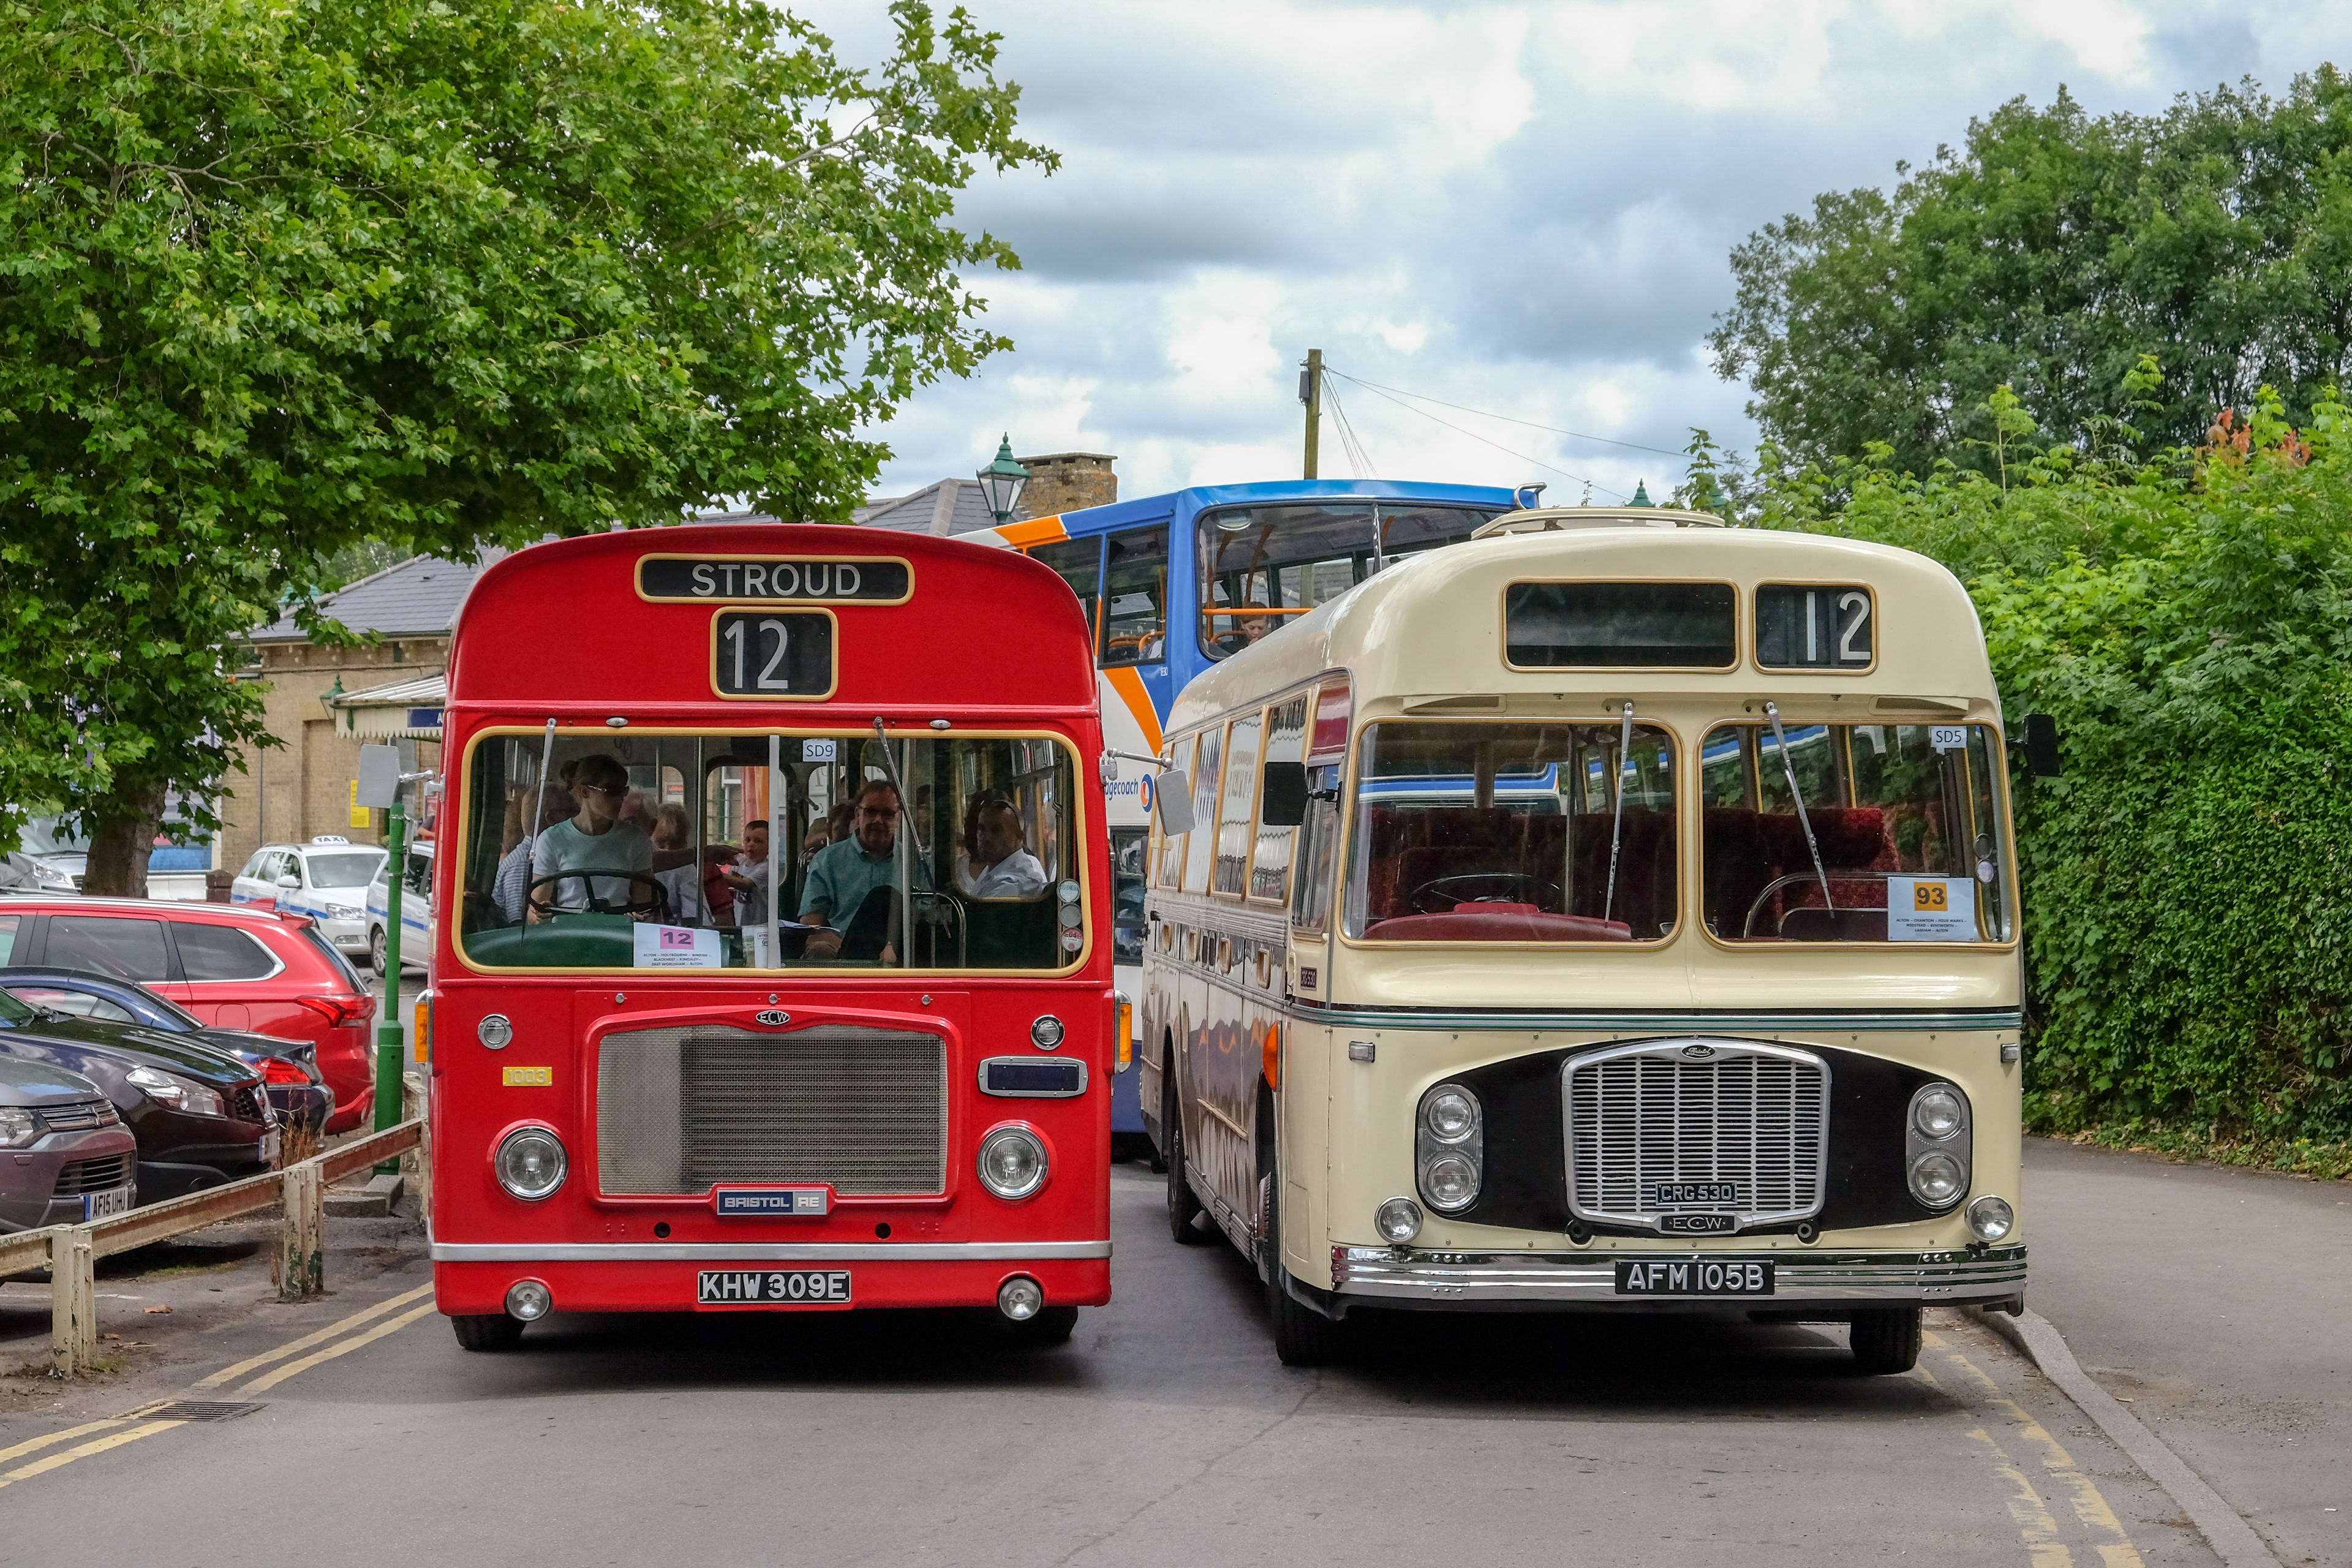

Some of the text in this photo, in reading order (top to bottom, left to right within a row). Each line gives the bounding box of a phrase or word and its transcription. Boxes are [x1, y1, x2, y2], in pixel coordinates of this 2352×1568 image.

[691, 564, 861, 596] STROUD
[1806, 591, 1871, 661] 12
[724, 619, 788, 690] 12
[1936, 730, 1962, 743] SD5
[806, 745, 833, 757] SD9
[1105, 778, 1138, 801] agecoach
[1917, 887, 1945, 905] 93
[663, 932, 692, 945] 12
[760, 1011, 787, 1023] ECW
[507, 1069, 546, 1084] 1003
[93, 1190, 126, 1217] AF15 UHU
[725, 1197, 820, 1208] BRISTOL RE
[1672, 1217, 1724, 1229] ECW
[703, 1274, 846, 1299] KHW 309E
[1627, 1264, 1764, 1291] AFM 105B
